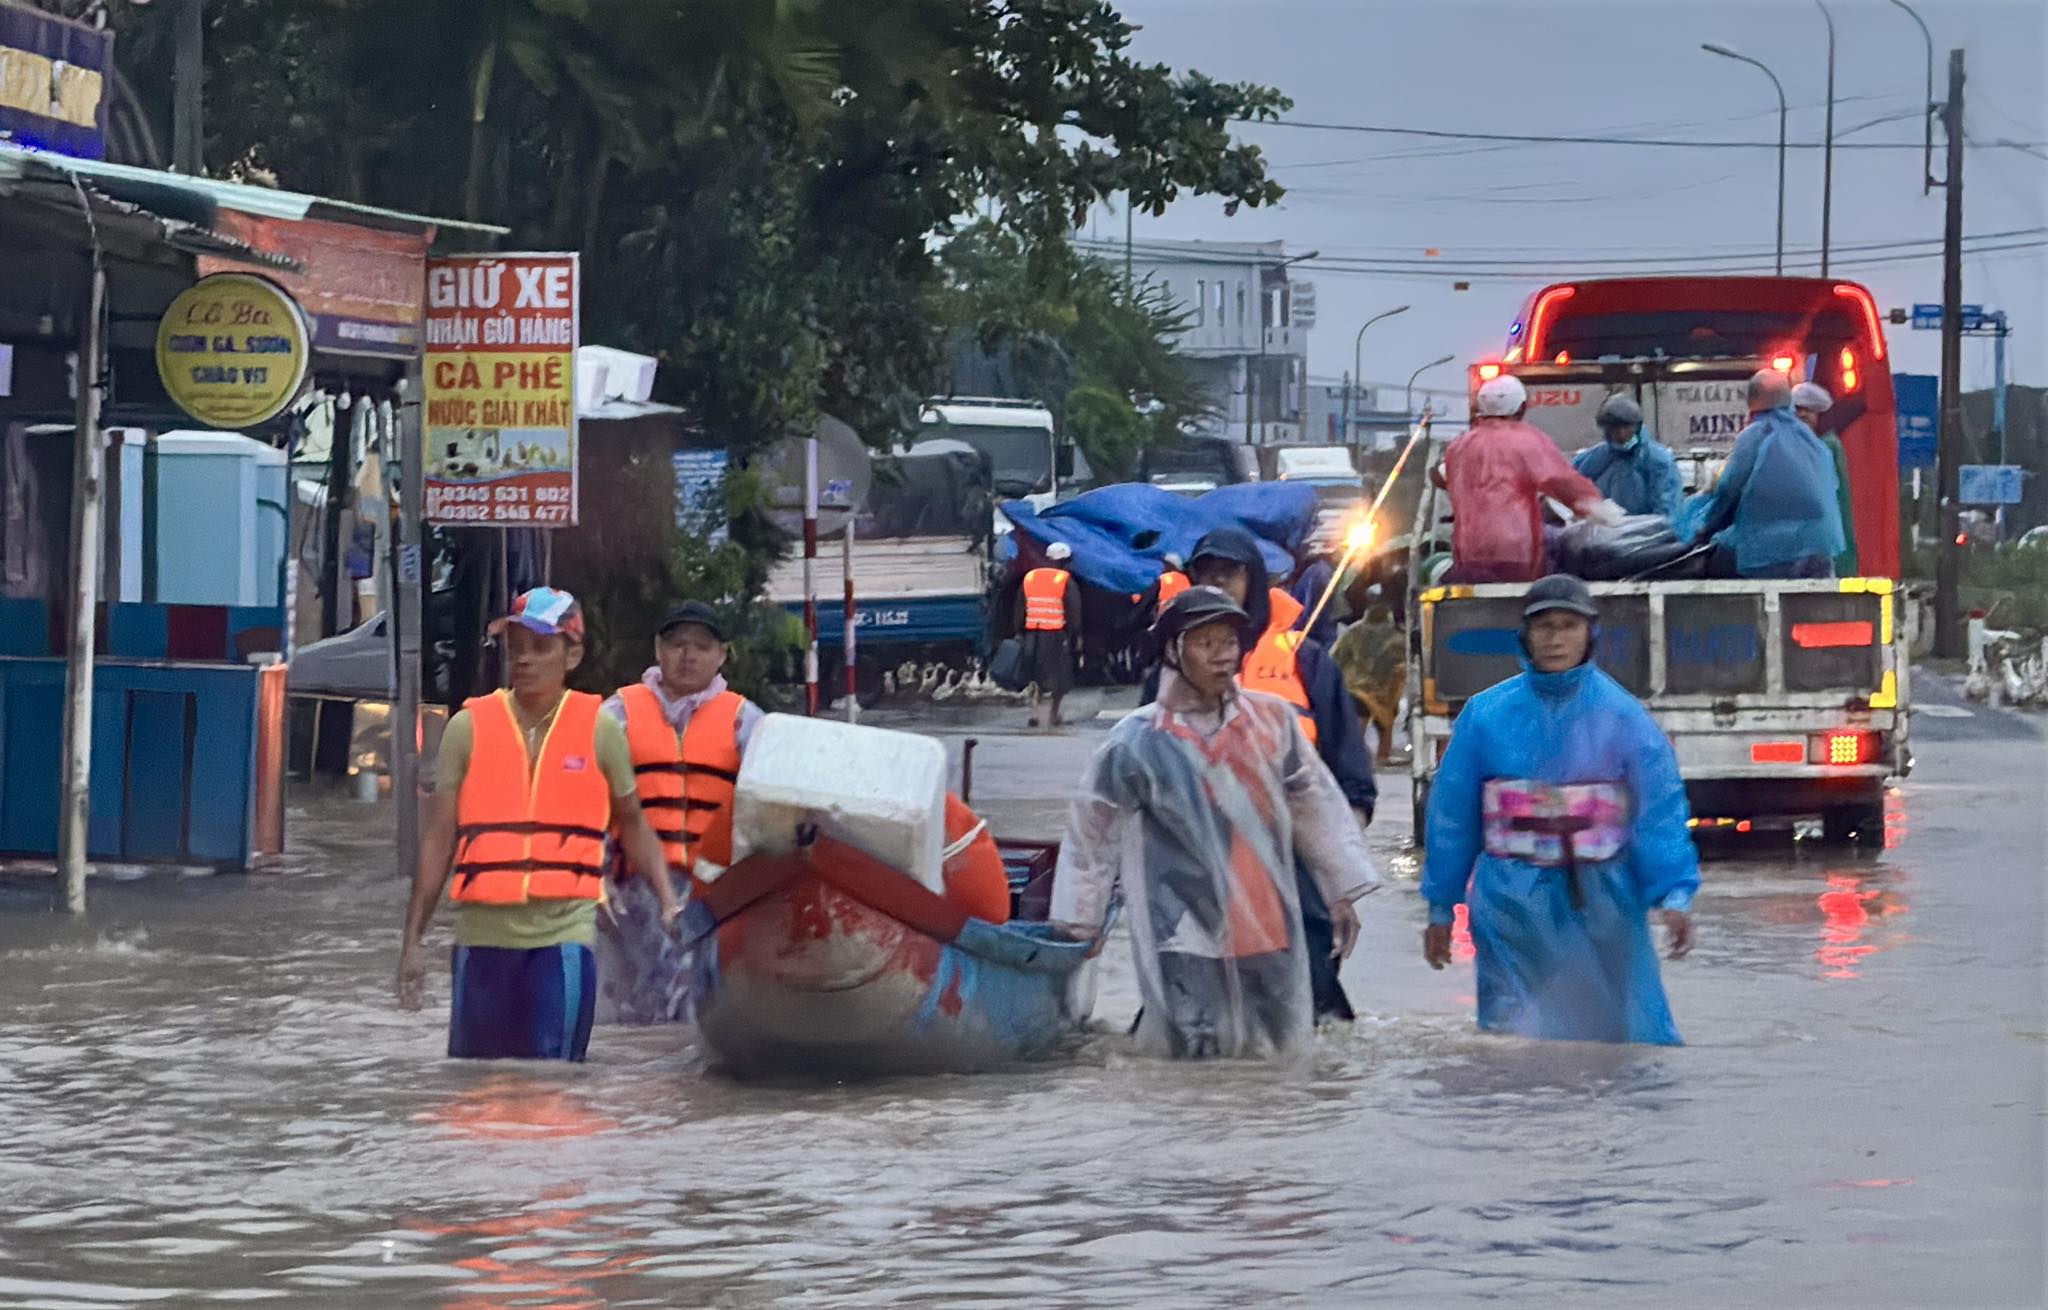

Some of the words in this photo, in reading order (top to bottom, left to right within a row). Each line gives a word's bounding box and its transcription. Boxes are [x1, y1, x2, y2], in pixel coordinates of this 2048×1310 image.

[429, 260, 506, 308] GIỮ
[514, 267, 570, 308] XE
[426, 311, 479, 350] NHẬN
[484, 309, 515, 344] GỬI
[520, 312, 572, 344] HÀNG
[435, 356, 482, 390] CÀ
[494, 357, 563, 389] PHÊ
[483, 392, 518, 426] GIẢI
[523, 395, 569, 426] KHÁT
